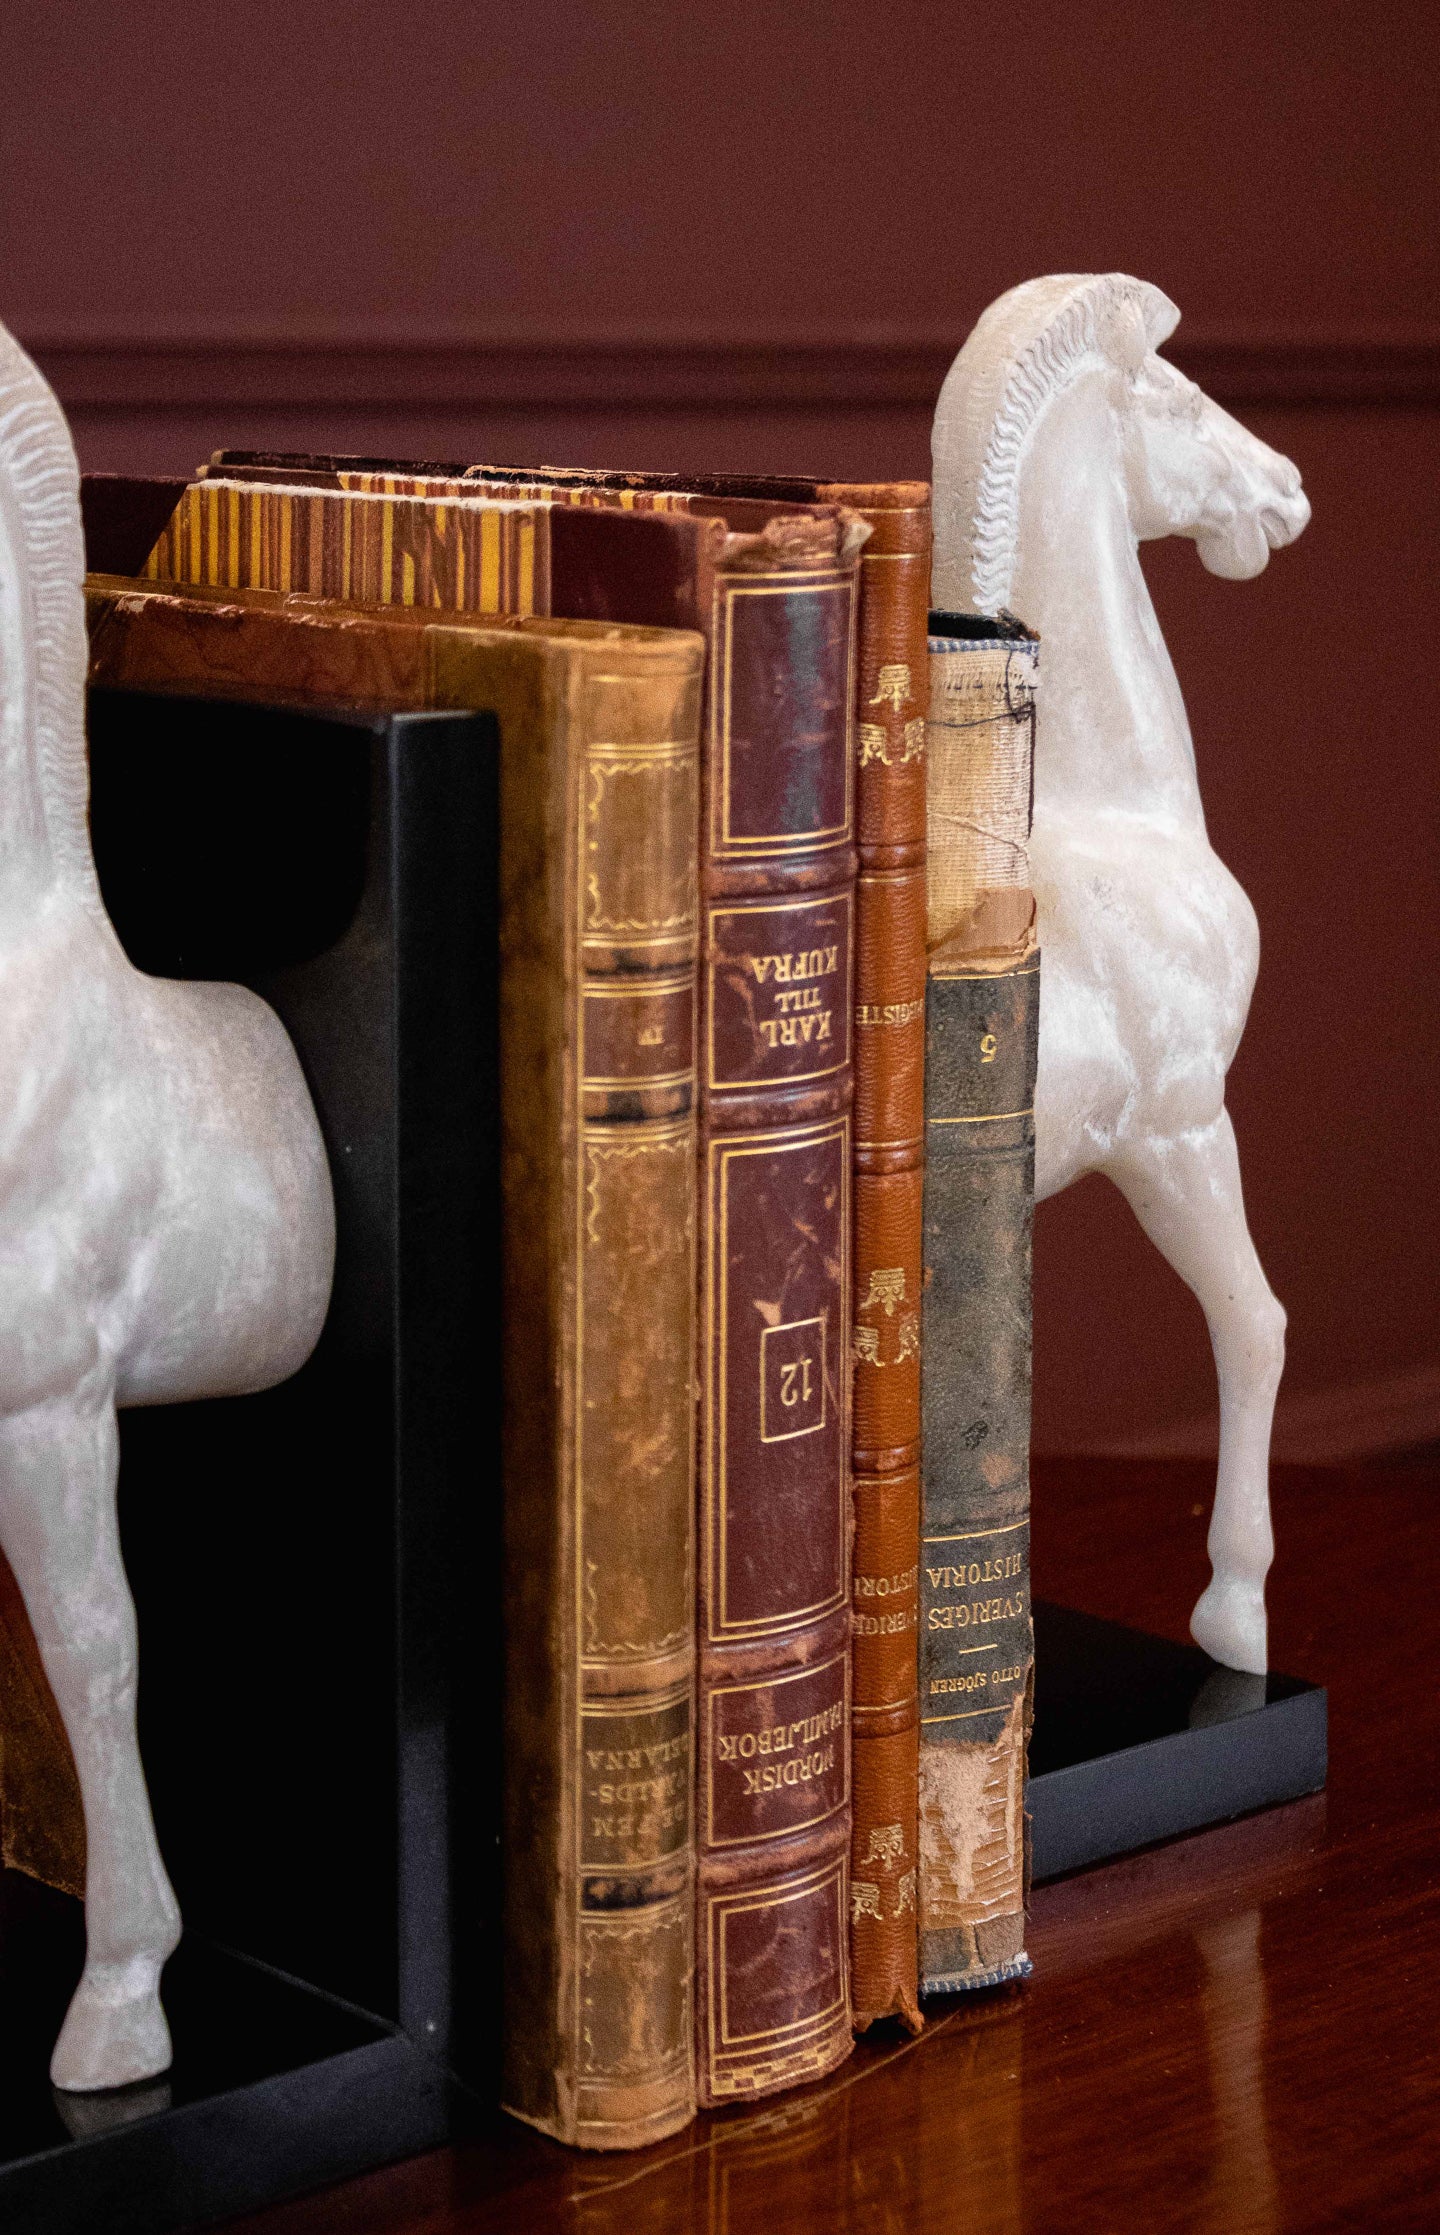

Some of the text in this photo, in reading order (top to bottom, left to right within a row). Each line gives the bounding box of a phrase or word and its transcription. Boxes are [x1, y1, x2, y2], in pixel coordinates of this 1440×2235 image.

[751, 945, 838, 983] KUFRA
[775, 987, 822, 1012] TILL
[760, 1011, 831, 1047] KARL
[980, 1034, 998, 1063] 5
[781, 1358, 813, 1406] 12
[926, 1552, 1022, 1588] HISTORIA
[928, 1591, 1024, 1631] SVERIGES
[929, 1665, 1021, 1694] OTTO SJÖGREN
[719, 1700, 842, 1760] FAMILJEBOK
[742, 1744, 834, 1795] NORDISK
